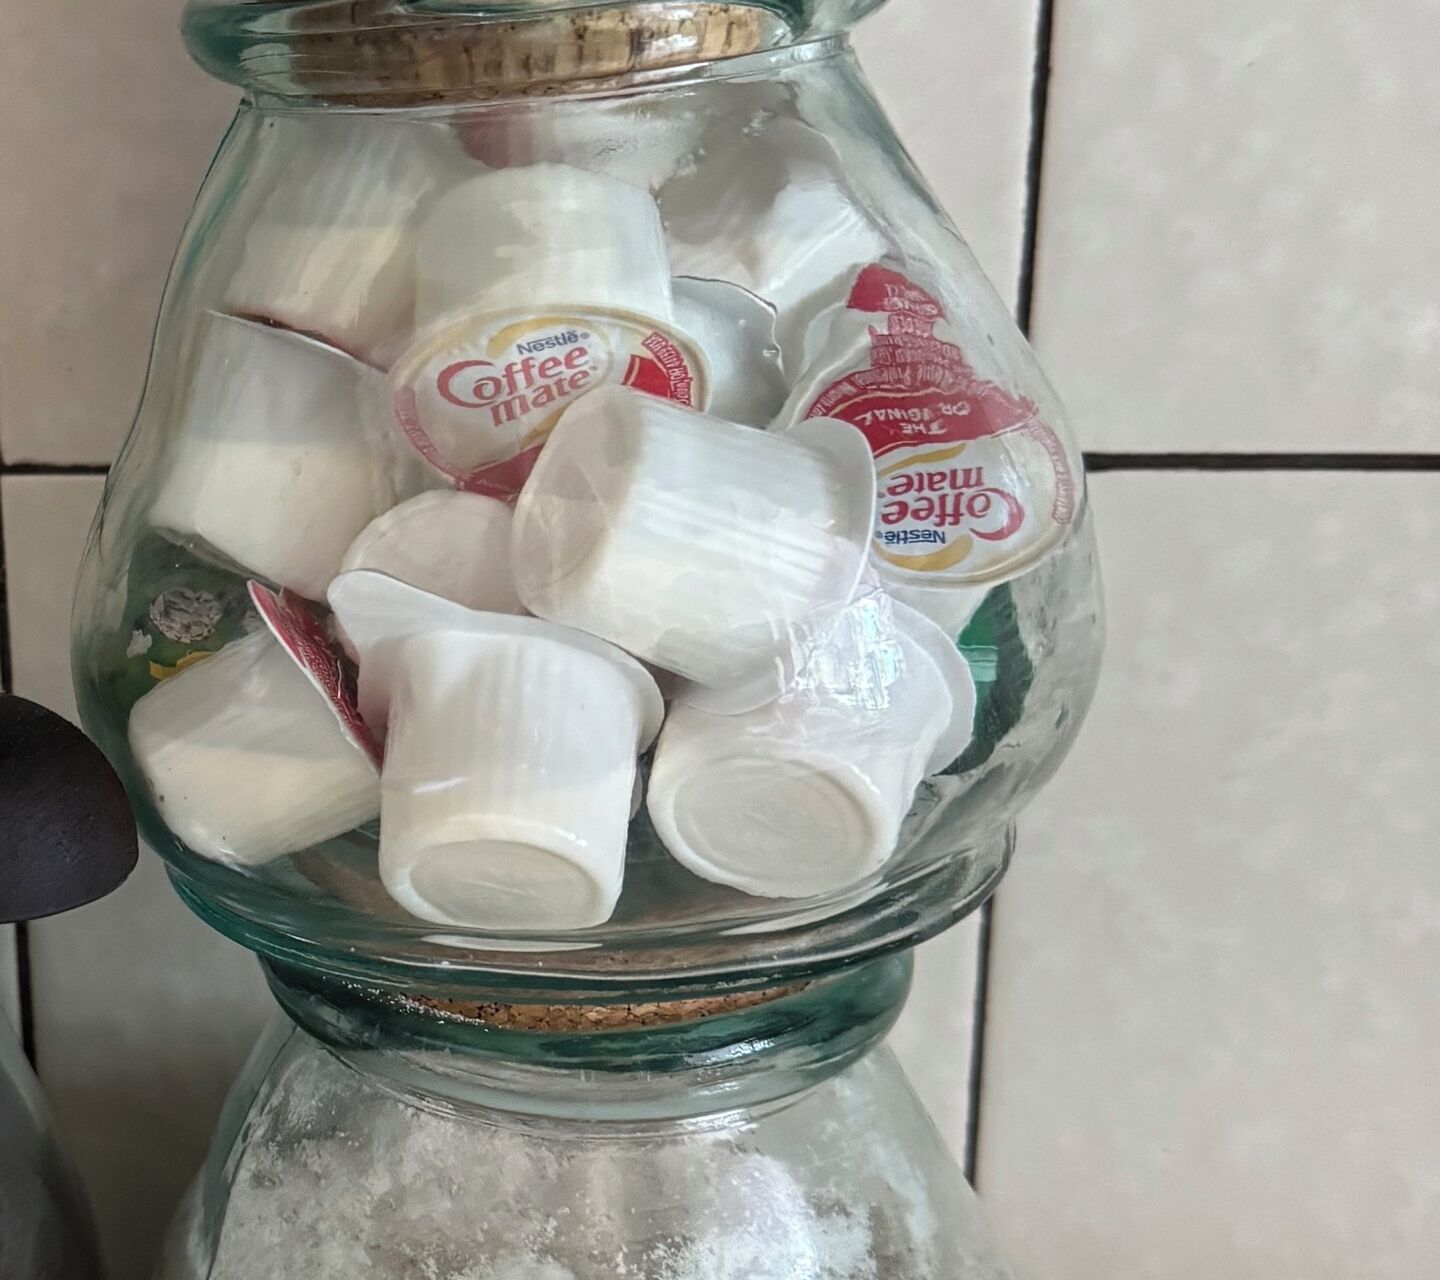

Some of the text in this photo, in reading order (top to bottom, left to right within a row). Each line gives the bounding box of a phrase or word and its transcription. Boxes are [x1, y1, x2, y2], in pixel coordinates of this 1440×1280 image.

[436, 346, 589, 409] Coffee
[489, 369, 590, 427] mate
[902, 420, 948, 436] THE
[886, 466, 984, 493] mate
[880, 487, 1025, 542] Coffee
